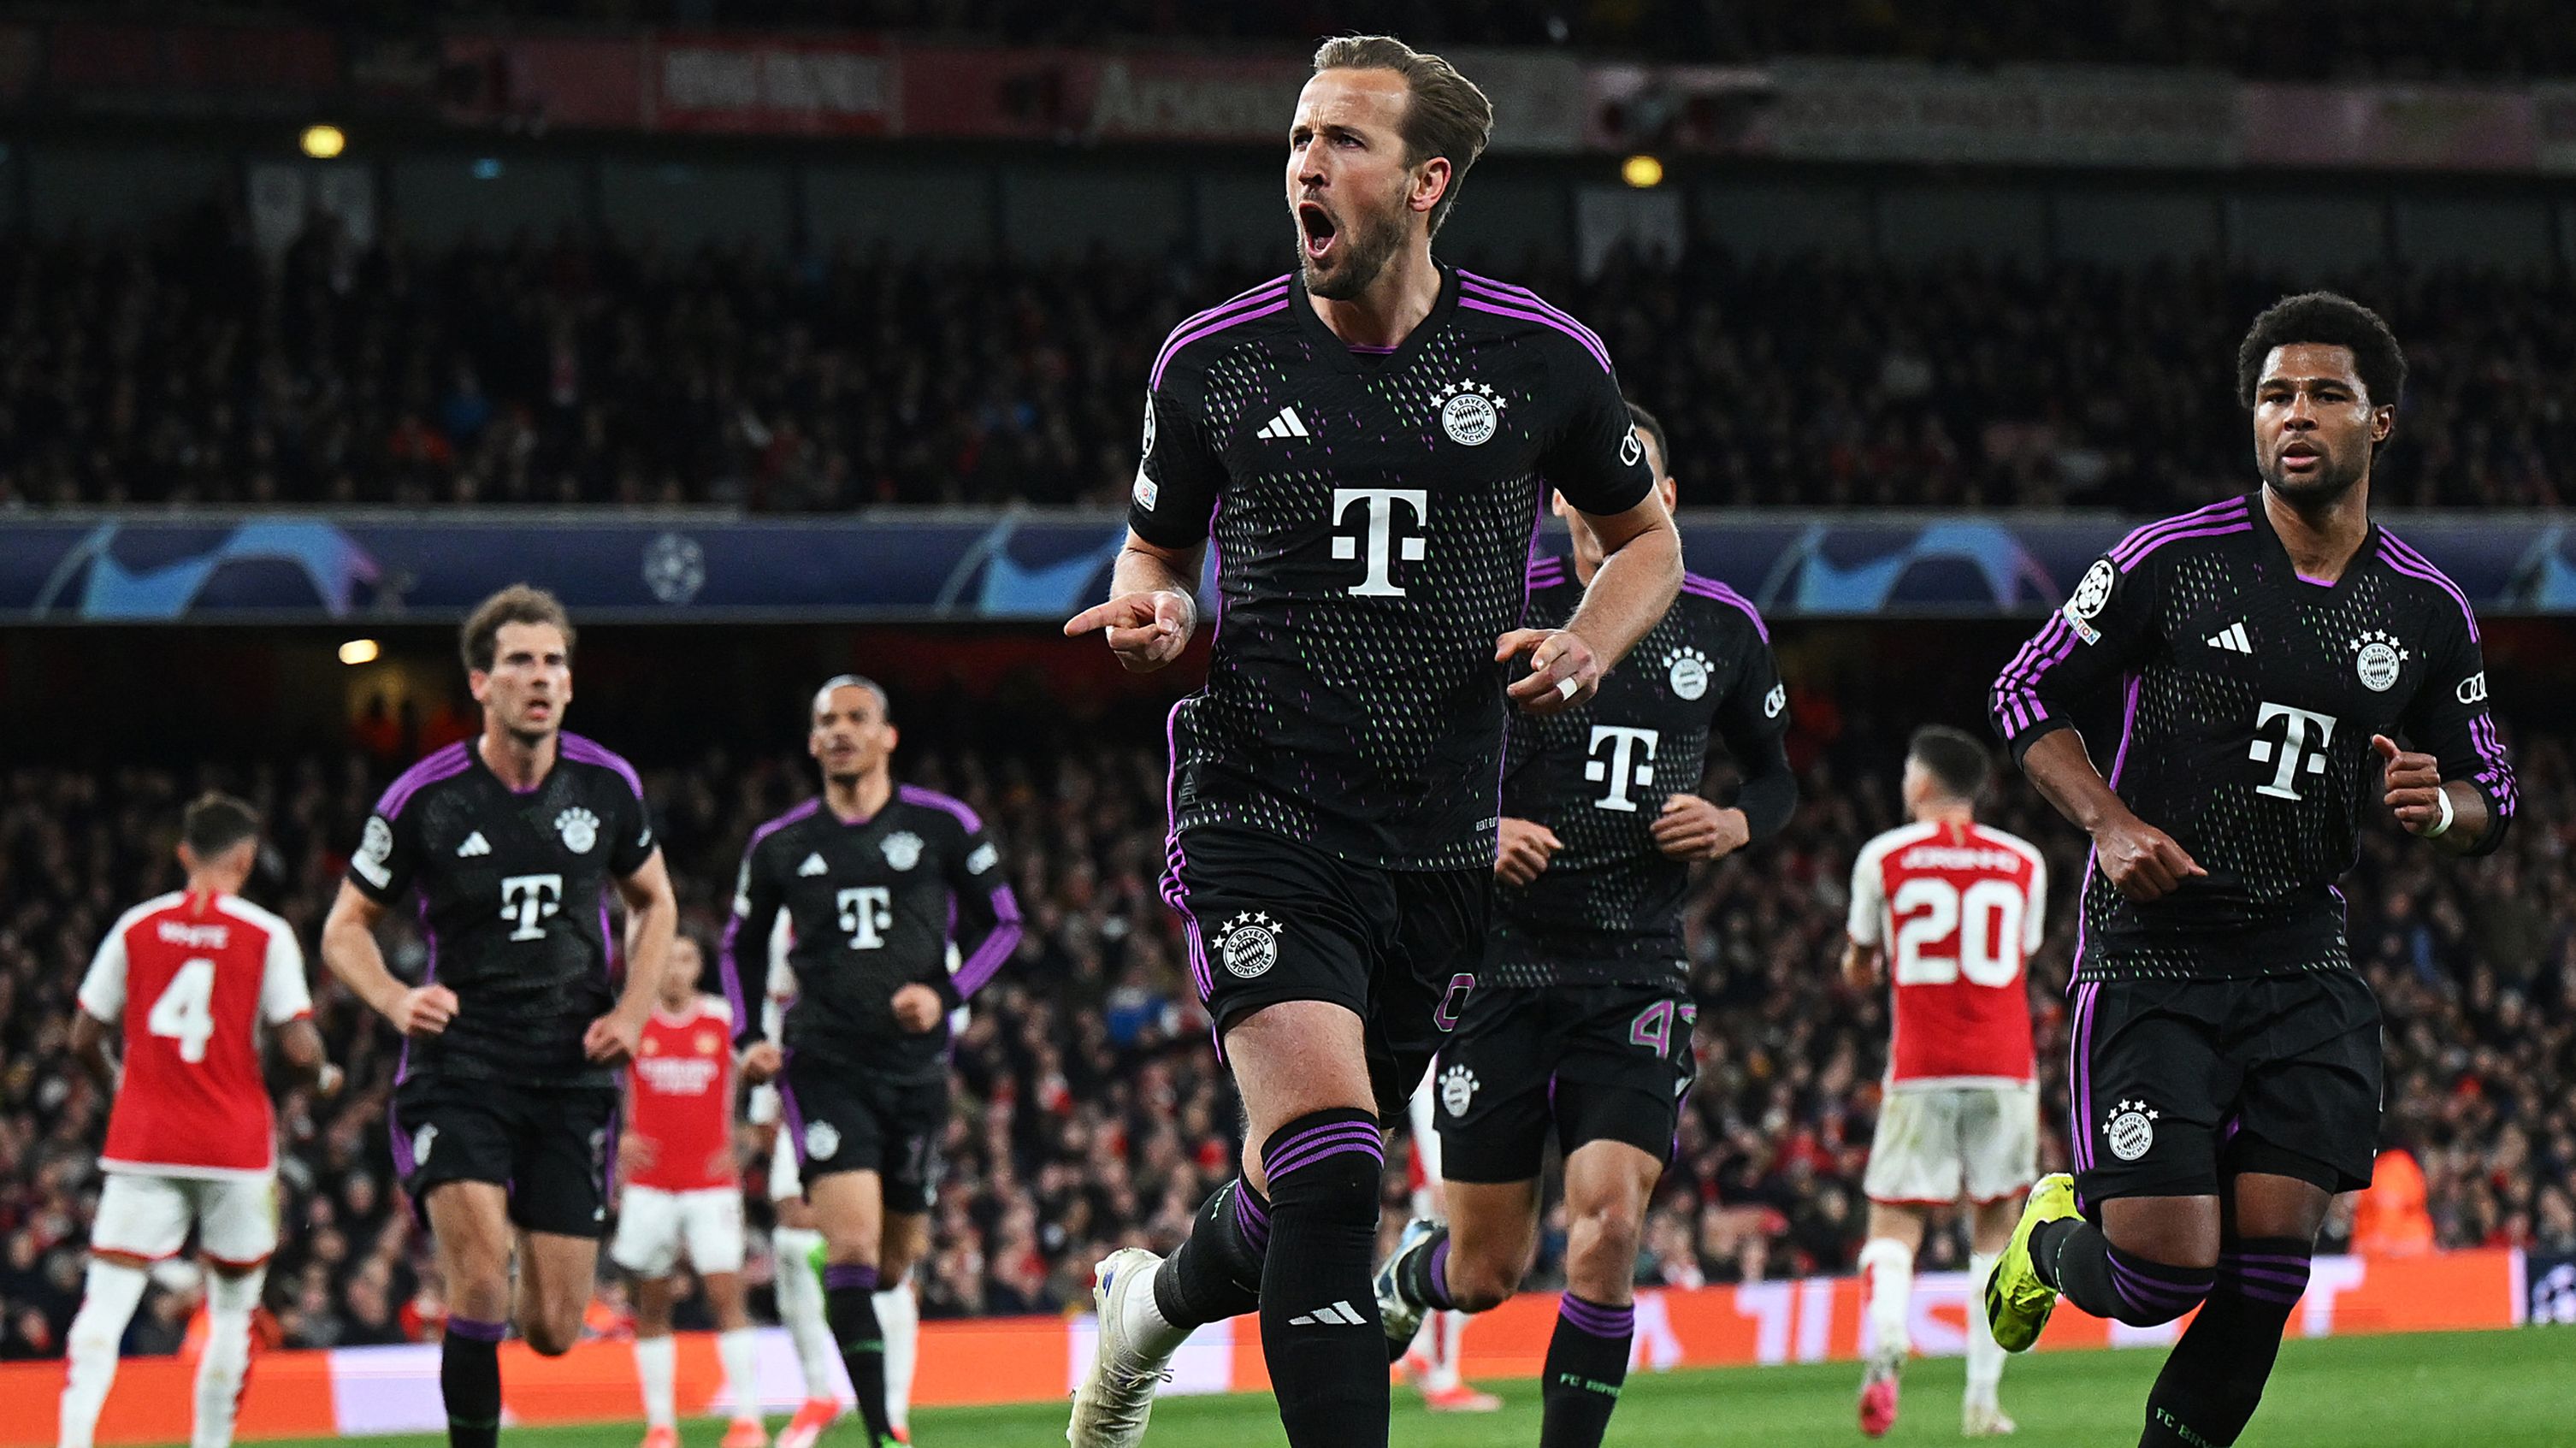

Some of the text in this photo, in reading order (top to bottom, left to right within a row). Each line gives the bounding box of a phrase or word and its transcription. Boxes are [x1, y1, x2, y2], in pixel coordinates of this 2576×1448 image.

[1448, 399, 1491, 417] FC BAYERN
[1332, 488, 1427, 597] T
[2371, 648, 2396, 667] BAYERN
[1585, 725, 1659, 813] T
[2249, 701, 2337, 801] T
[500, 873, 563, 942] T
[836, 886, 893, 950] T
[1893, 877, 2024, 989] 20
[1228, 931, 1271, 953] FC BAYERN
[147, 957, 216, 1064] 4
[2119, 1117, 2146, 1130] BAYERN
[2155, 1407, 2176, 1428] FC
